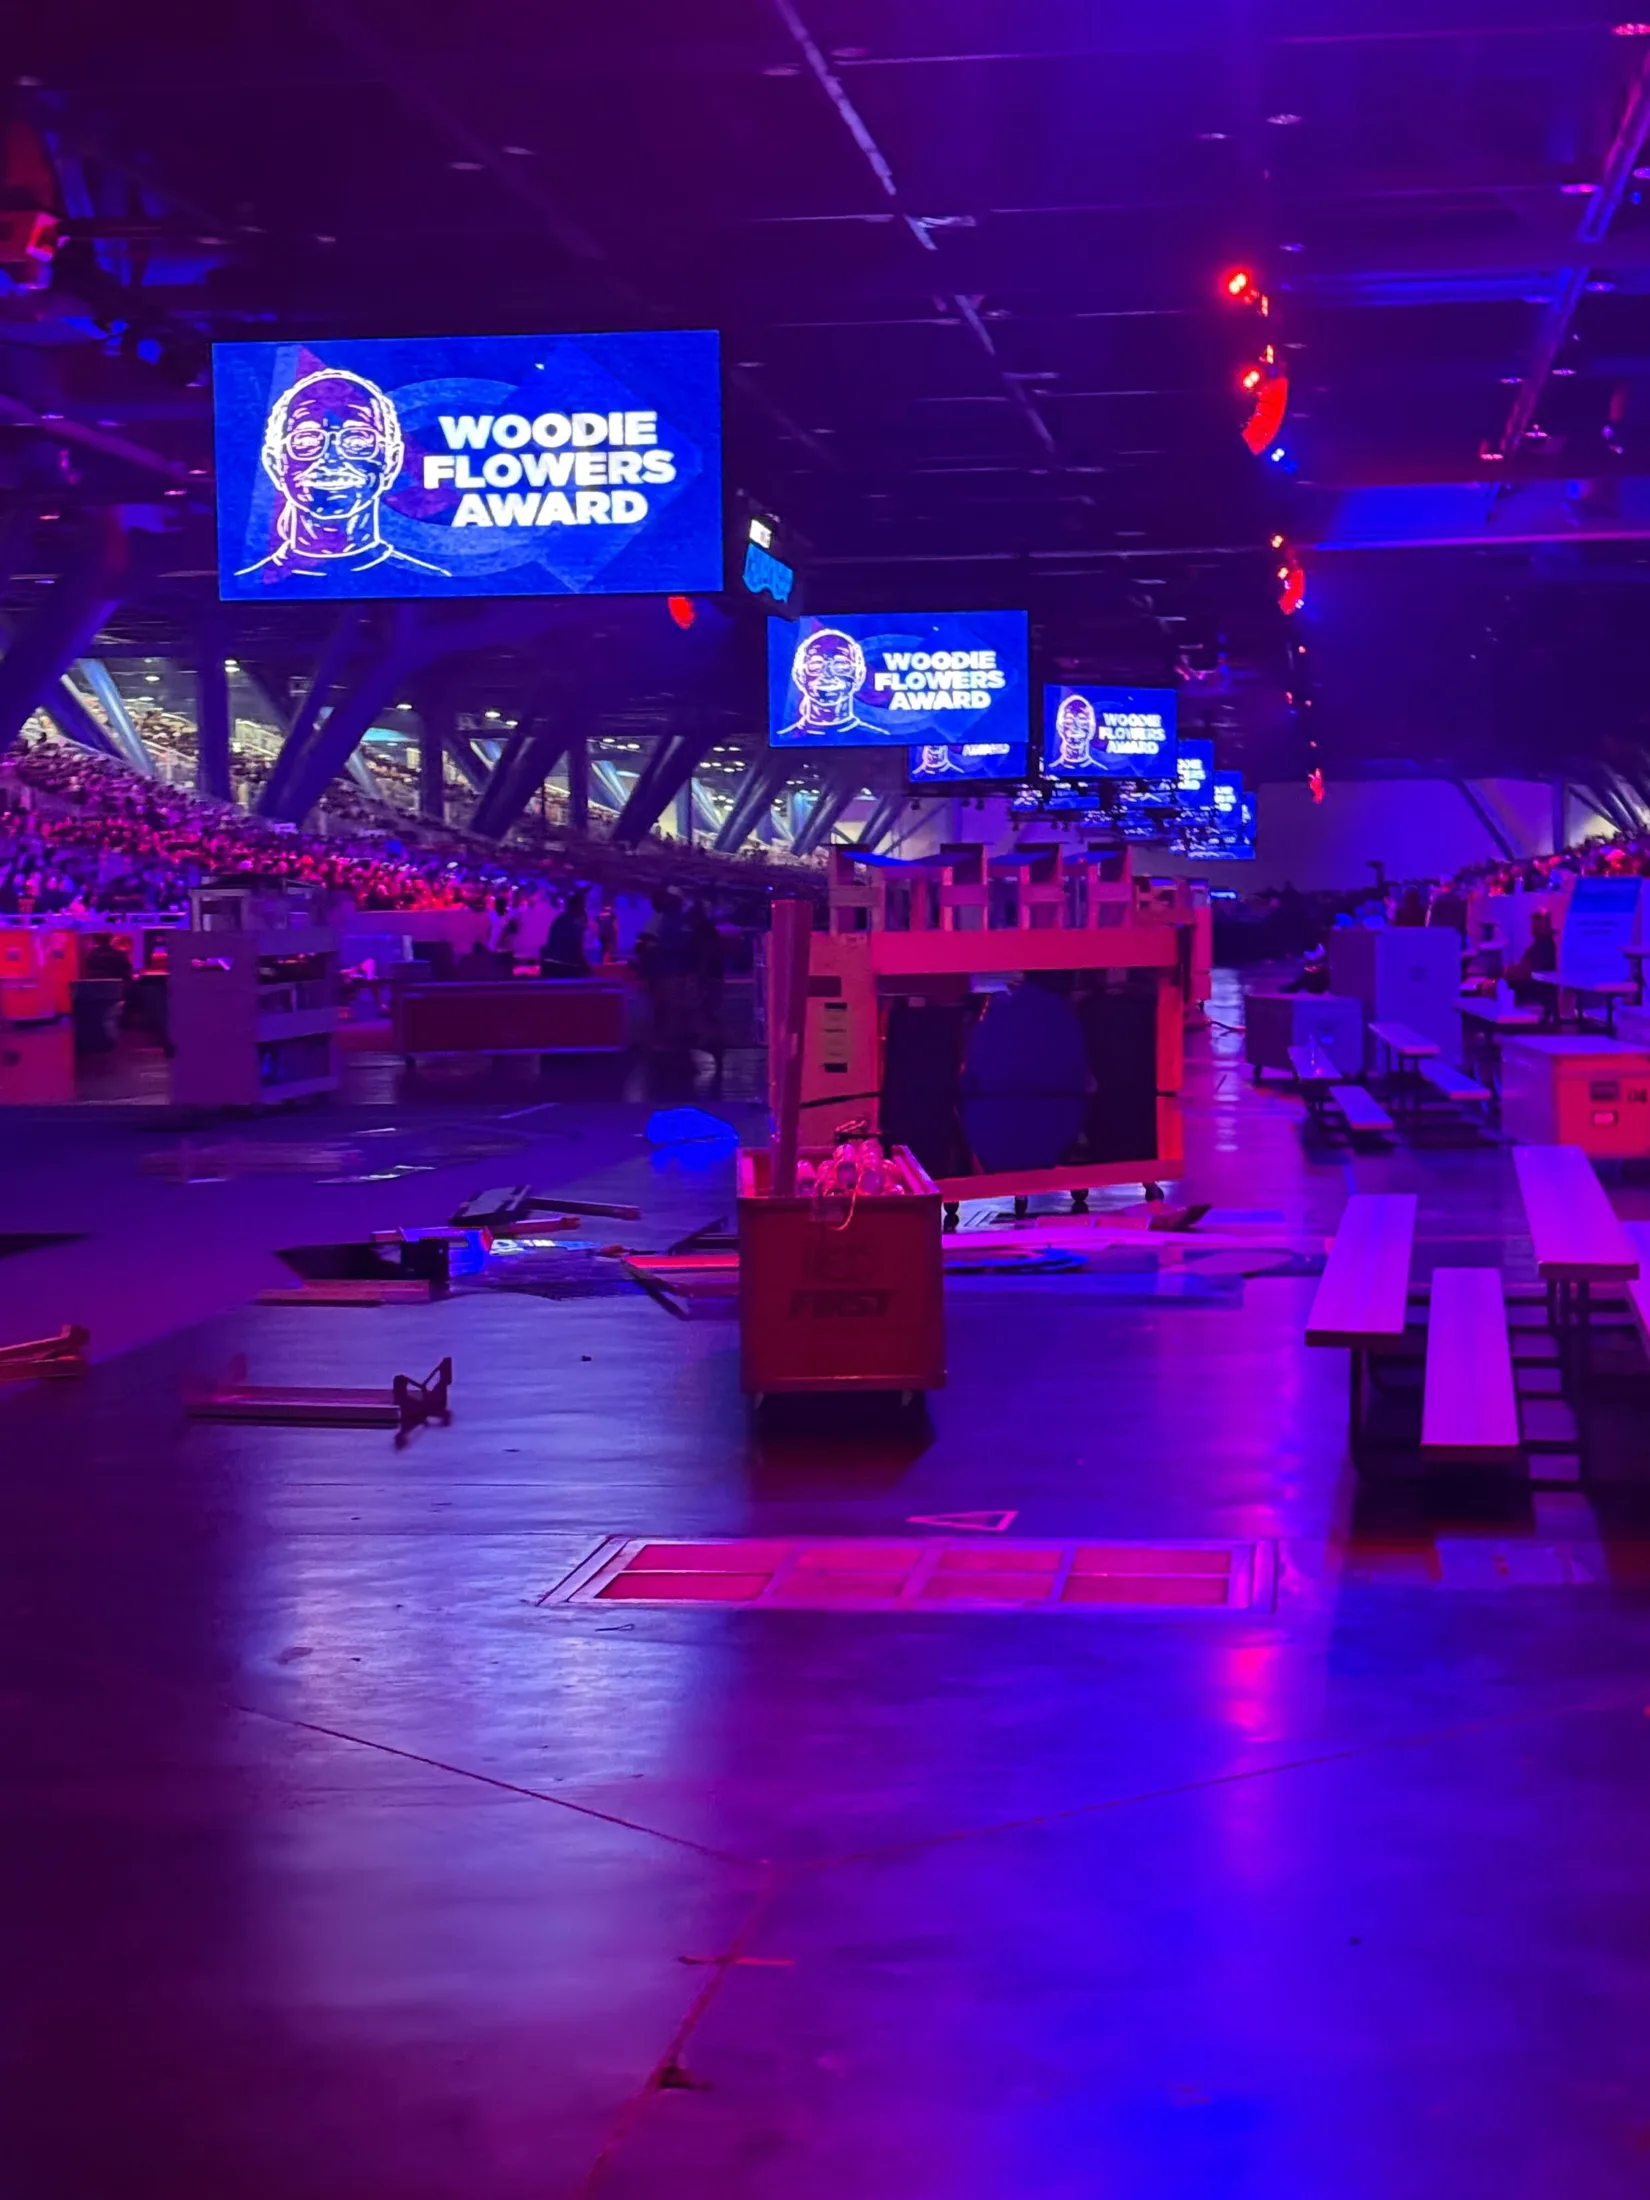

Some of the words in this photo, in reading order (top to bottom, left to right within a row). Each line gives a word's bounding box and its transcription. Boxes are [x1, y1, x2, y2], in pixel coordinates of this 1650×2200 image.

[438, 410, 658, 450] WOODIE
[422, 449, 677, 490] FLOWERS
[450, 489, 649, 528] AWARD
[882, 650, 997, 671] WOODIE
[873, 670, 1006, 691] FLOWERS
[888, 690, 992, 711] AWARD
[1102, 713, 1162, 728] WOODIE
[1098, 726, 1166, 742] FLOWERS
[1106, 740, 1160, 755] AWARD
